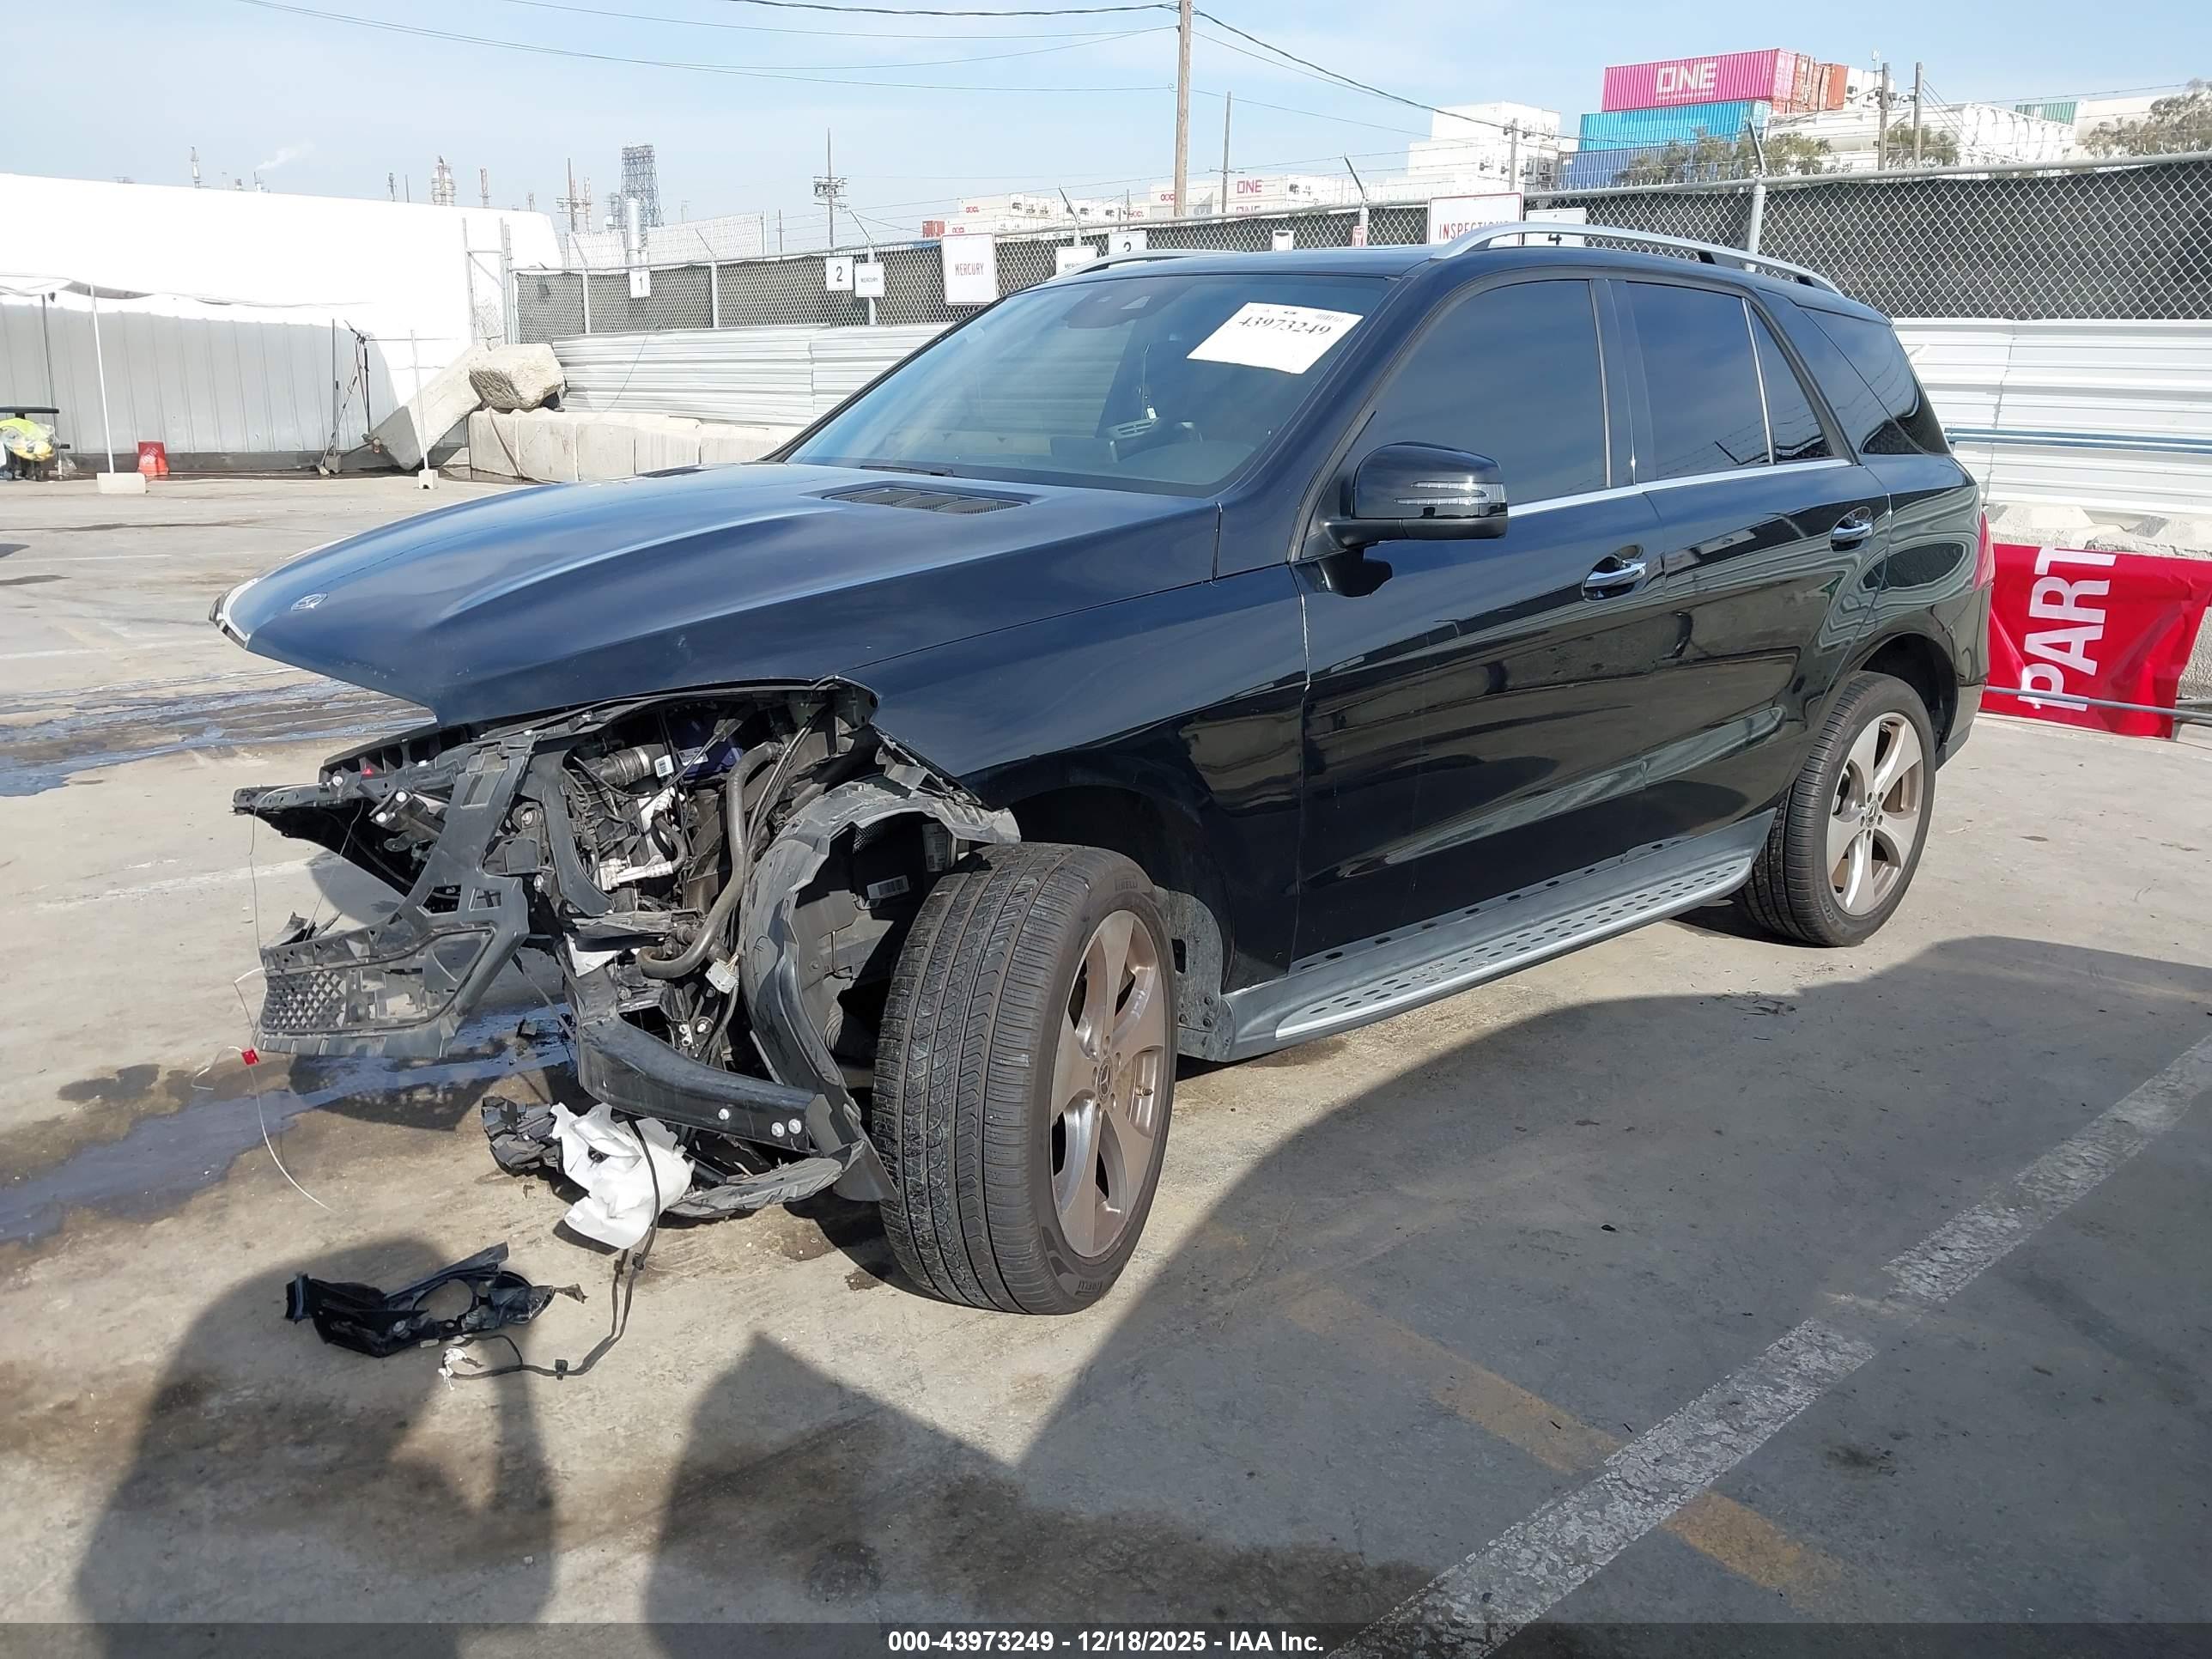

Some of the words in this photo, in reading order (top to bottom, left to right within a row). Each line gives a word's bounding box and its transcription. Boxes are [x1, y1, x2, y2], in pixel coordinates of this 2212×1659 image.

[1656, 63, 1717, 93] ONE
[1237, 179, 1262, 193] ONE
[1160, 193, 1175, 202] OOC
[836, 265, 842, 282] 2
[955, 262, 984, 276] MERCURY
[639, 276, 643, 290] 1
[1238, 316, 1332, 335] 43973249
